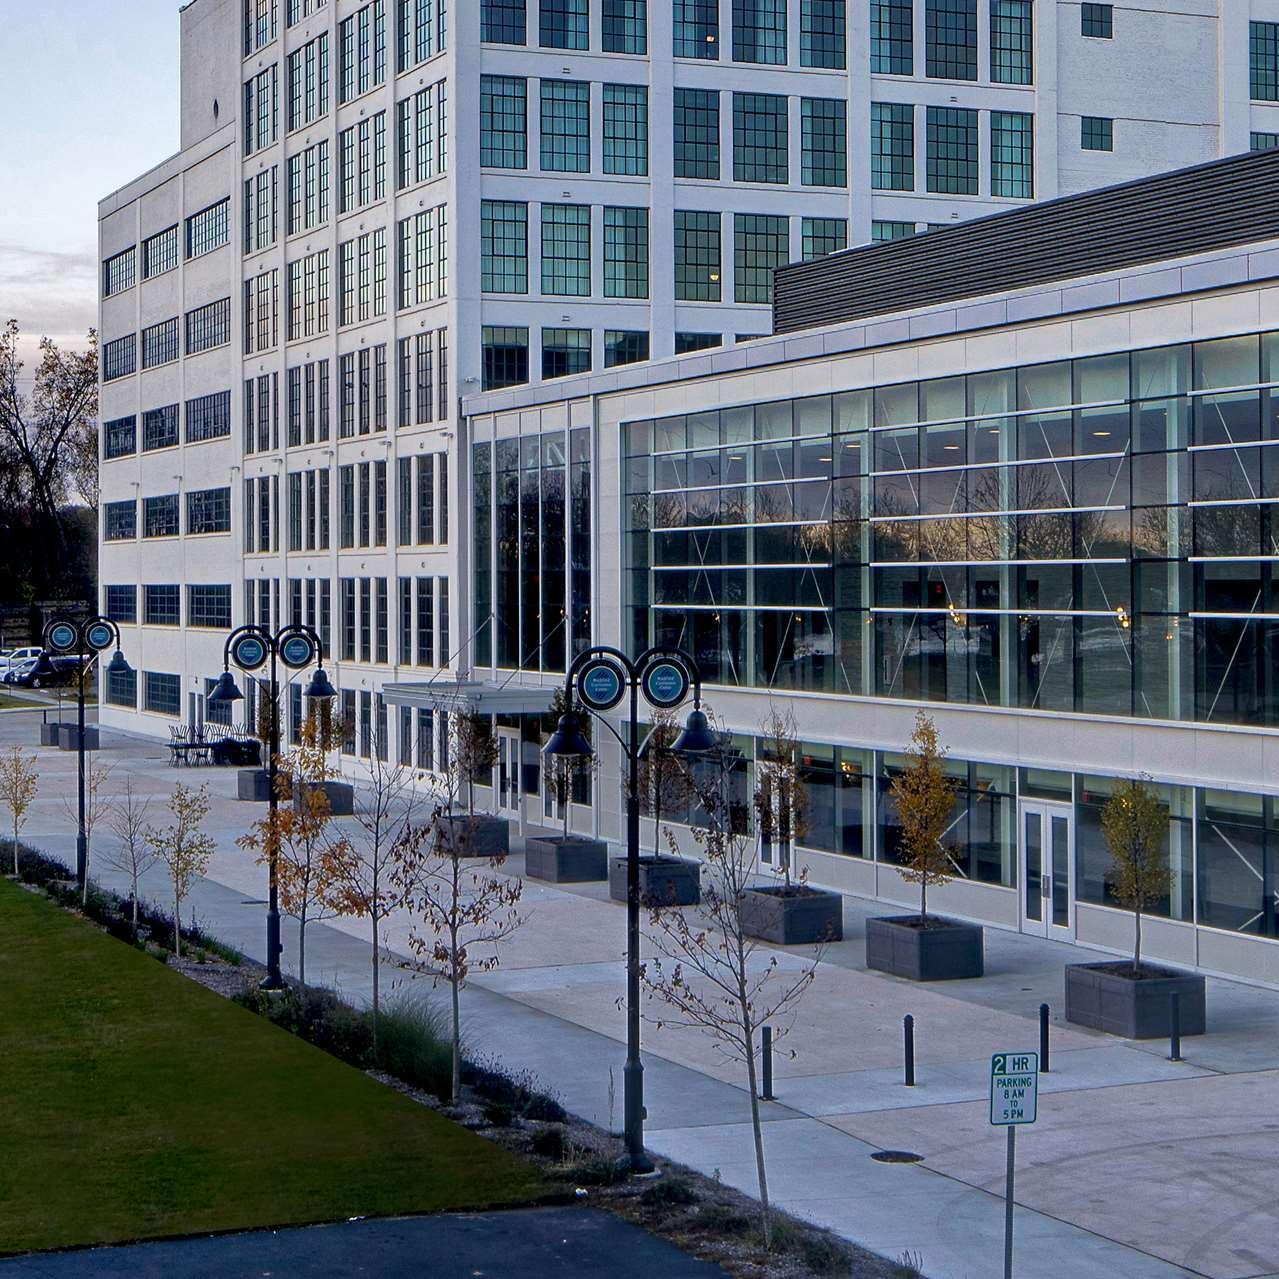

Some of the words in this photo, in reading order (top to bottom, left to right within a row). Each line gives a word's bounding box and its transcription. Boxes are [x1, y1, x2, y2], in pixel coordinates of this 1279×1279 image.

[994, 1056, 1004, 1074] 2
[1012, 1057, 1029, 1071] HR
[996, 1077, 1032, 1088] PARKING
[1003, 1090, 1010, 1099] 8
[1011, 1089, 1025, 1099] AM
[1010, 1100, 1018, 1108] TO
[1003, 1110, 1009, 1119] 5
[1010, 1109, 1024, 1119] PM
